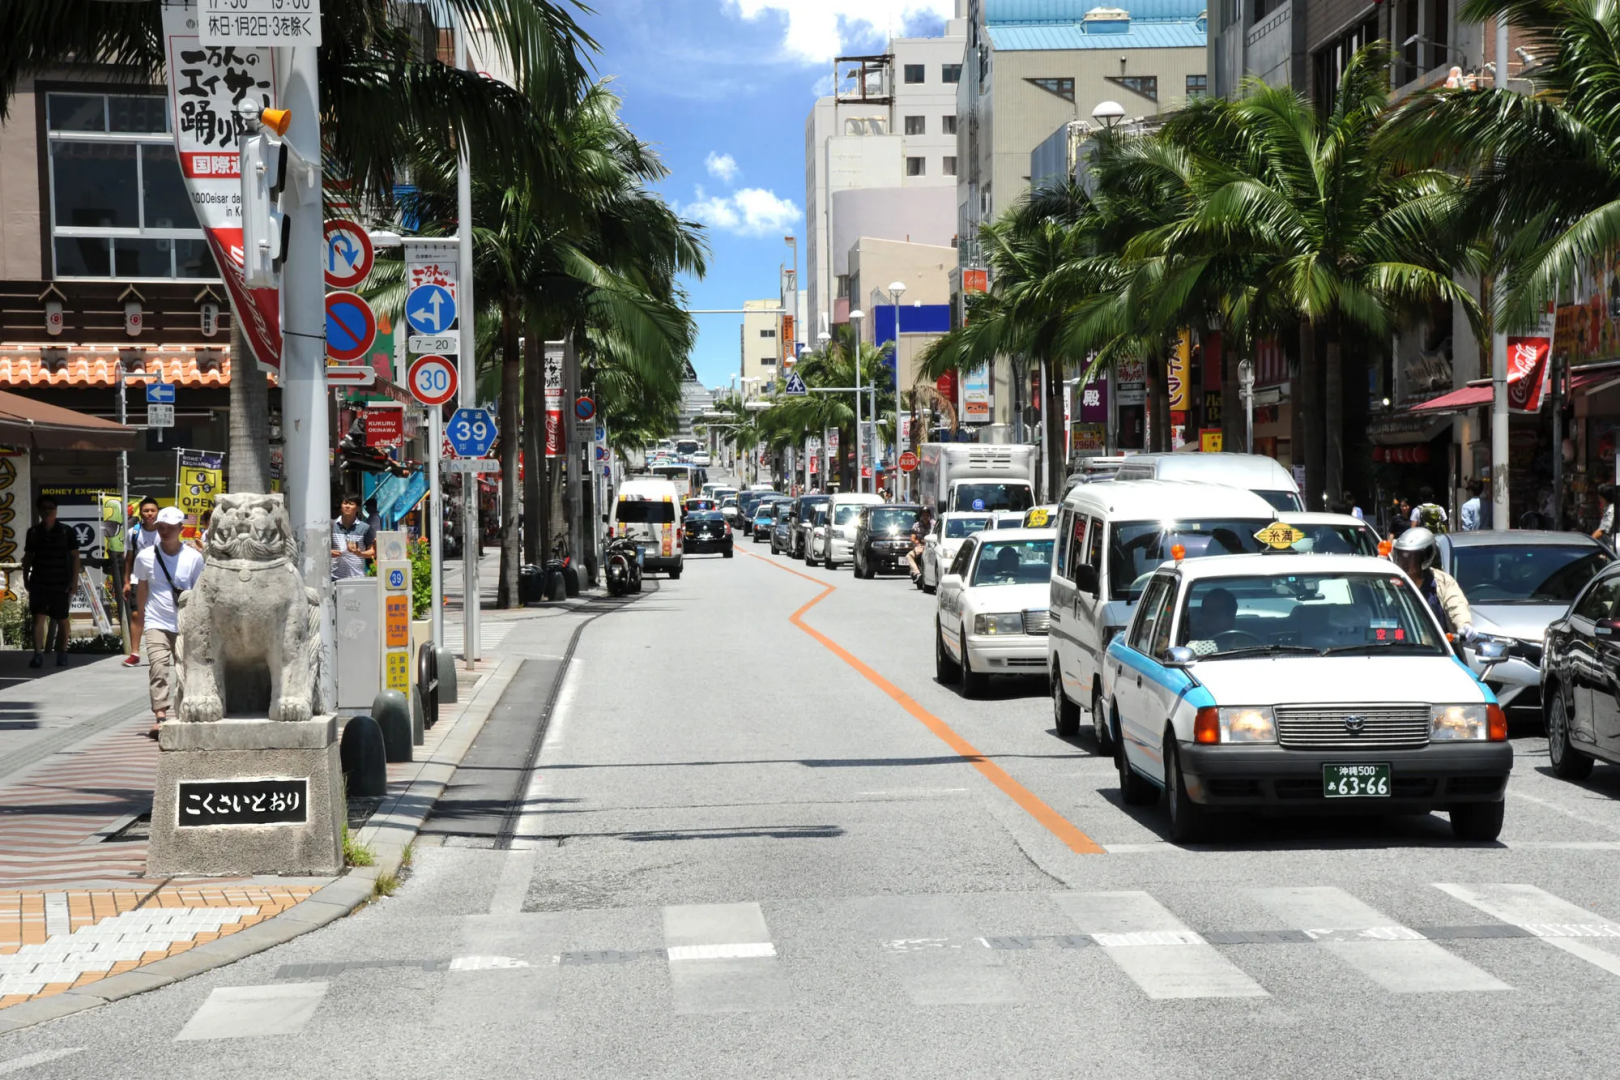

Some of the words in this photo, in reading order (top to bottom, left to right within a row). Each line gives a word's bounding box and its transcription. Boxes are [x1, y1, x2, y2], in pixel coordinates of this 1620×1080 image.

[420, 369, 447, 391] 30
[456, 421, 487, 441] 39
[182, 497, 215, 508] OPEN
[1268, 530, 1294, 542] 糸満
[391, 573, 402, 584] 39
[1376, 629, 1405, 640] 空車
[1339, 766, 1358, 776] 沖縄
[1358, 766, 1376, 776] 500
[1338, 777, 1387, 795] 63-66
[186, 791, 300, 815] こくさいとおり
